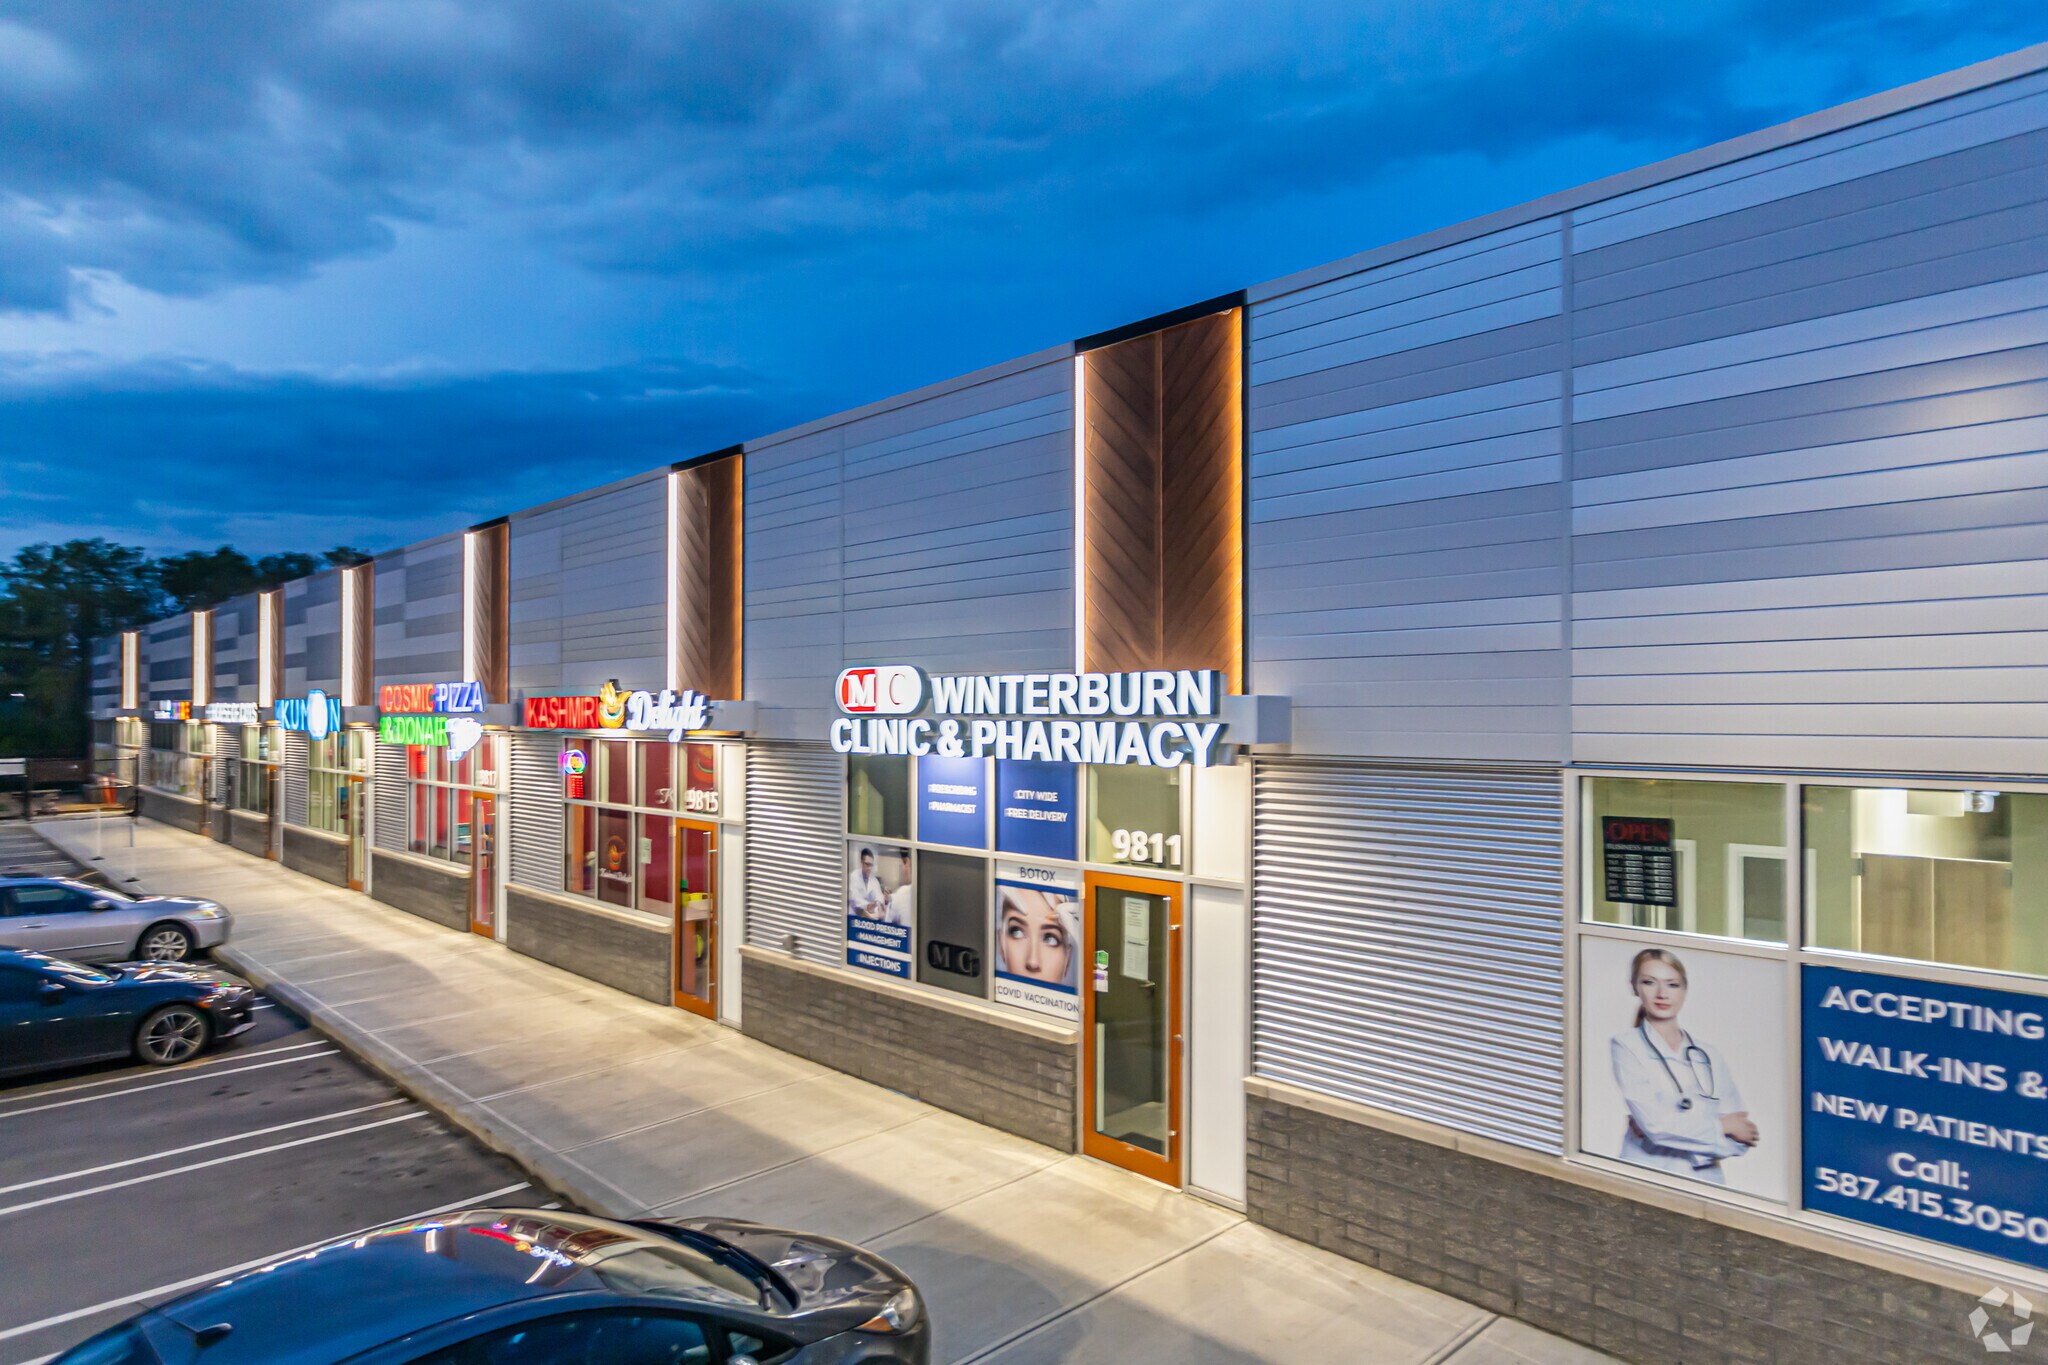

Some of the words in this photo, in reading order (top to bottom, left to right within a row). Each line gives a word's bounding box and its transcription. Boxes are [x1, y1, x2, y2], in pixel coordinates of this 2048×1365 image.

[383, 684, 435, 713] COSMIC
[434, 682, 484, 713] PIZZA
[930, 669, 1213, 716] WINTERBURN
[281, 688, 341, 740] KUMON
[526, 696, 600, 730] KASHMIRI
[626, 689, 706, 742] Delight
[384, 716, 394, 744] &
[394, 716, 449, 746] DONAIR
[830, 717, 931, 757] CLINIC
[936, 718, 966, 758] &
[972, 721, 1221, 768] PHARMACY
[686, 788, 719, 813] 9815
[1012, 789, 1036, 801] CITY
[1036, 790, 1059, 803] WIDE
[1004, 807, 1028, 820] FREE
[1028, 809, 1068, 823] DELIVERY
[1111, 828, 1182, 866] 9811
[1608, 822, 1670, 842] OPEN
[1020, 866, 1056, 882] BOTOX
[853, 918, 876, 931] BLOOD
[875, 922, 908, 938] PRESSURE
[857, 932, 902, 949] MANAGEMENT
[857, 953, 902, 972] INJECTIONS
[997, 985, 1022, 999] COVID
[1023, 991, 1079, 1013] VACCINATION
[1820, 985, 2045, 1039] ACCEPTING
[1817, 1036, 2008, 1092] WALK-INS
[2015, 1071, 2048, 1100] &
[1811, 1091, 1888, 1124] NEW
[1894, 1108, 2048, 1160] PATIENTS
[1888, 1152, 1969, 1191] Call:
[1814, 1166, 2048, 1245] 587.415.3050
